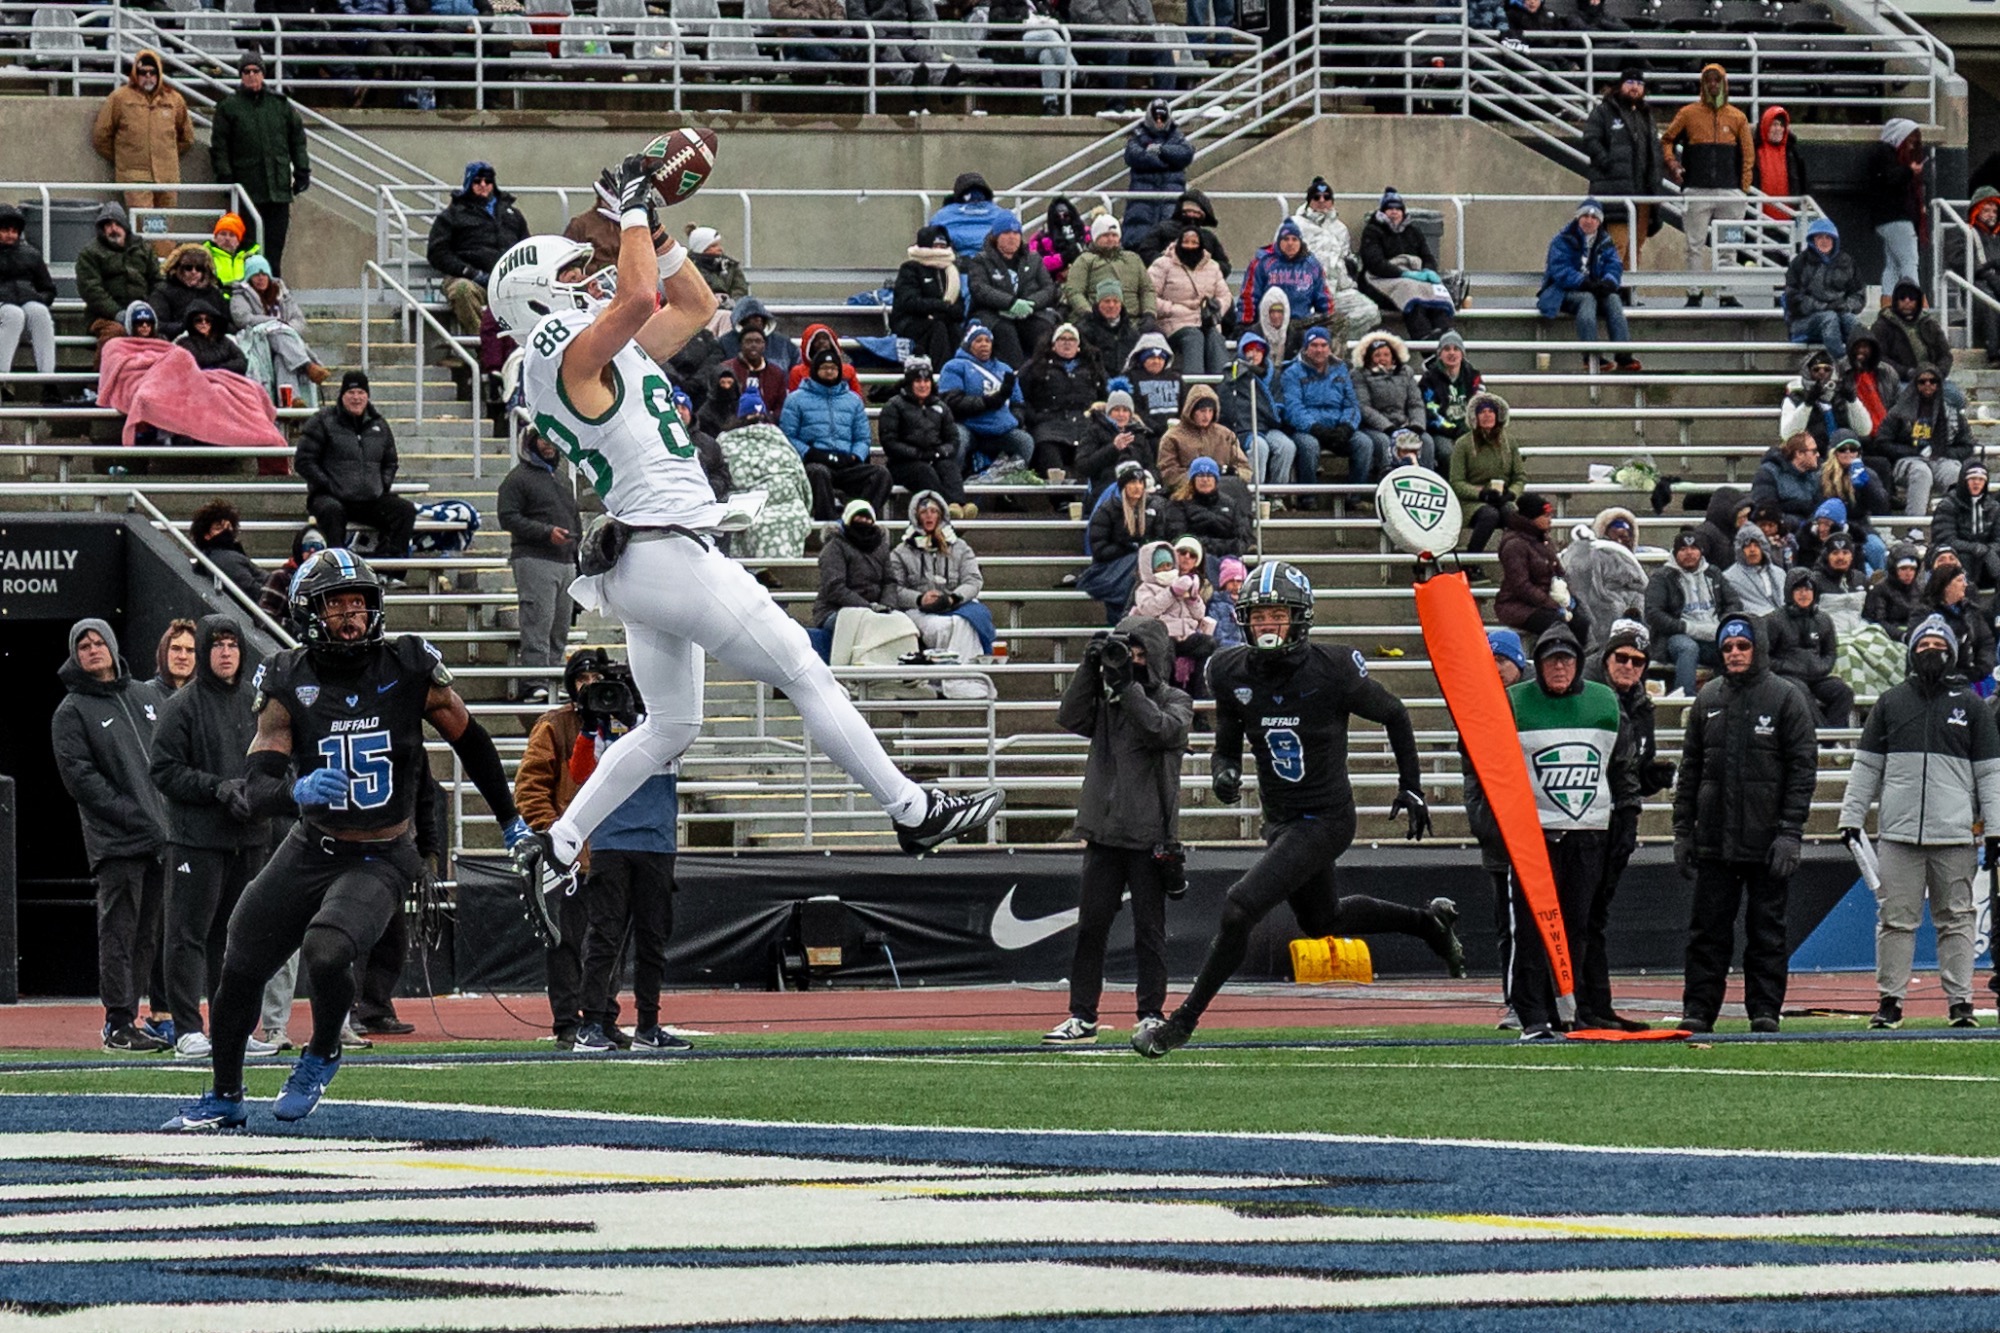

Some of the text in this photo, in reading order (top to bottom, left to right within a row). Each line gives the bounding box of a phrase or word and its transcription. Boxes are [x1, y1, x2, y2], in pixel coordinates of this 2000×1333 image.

[498, 245, 539, 281] OHIO
[533, 319, 571, 358] 88
[1398, 490, 1446, 512] MAC
[2, 578, 58, 594] ROOM
[330, 716, 380, 732] BUFFALO
[1261, 717, 1300, 727] BUFFALO
[1264, 728, 1306, 783] 9
[318, 730, 394, 811] 15
[1540, 766, 1600, 787] MAC
[1537, 909, 1559, 922] TUF
